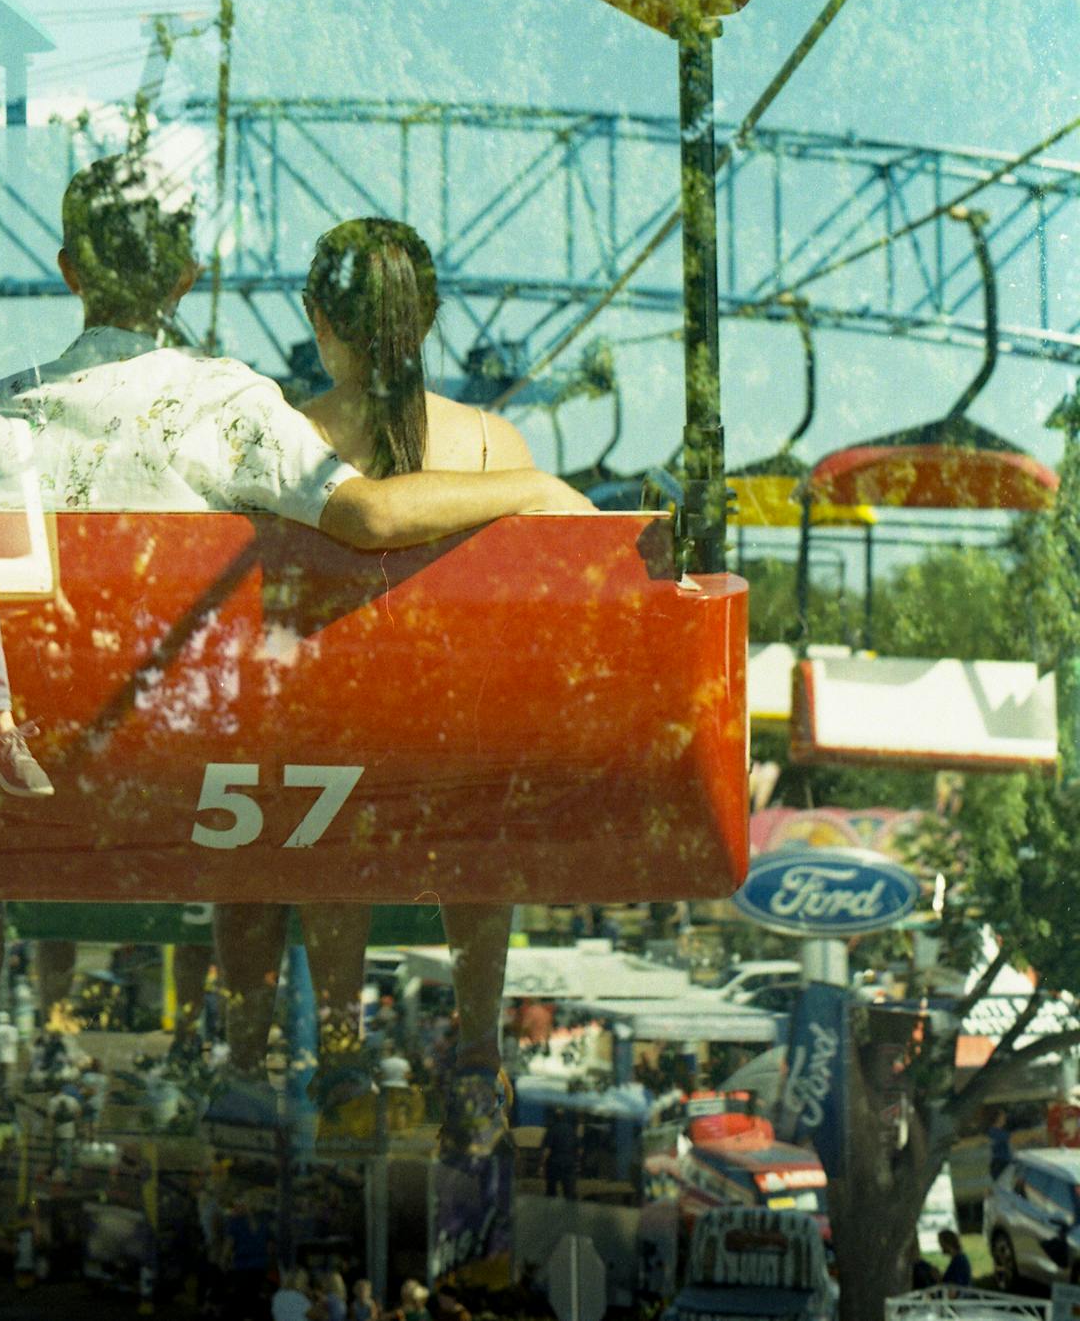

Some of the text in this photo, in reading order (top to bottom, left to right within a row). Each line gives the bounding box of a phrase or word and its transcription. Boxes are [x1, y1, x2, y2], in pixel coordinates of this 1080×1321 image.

[190, 762, 366, 850] 57
[770, 865, 887, 917] Ford
[785, 1021, 839, 1128] Ford
